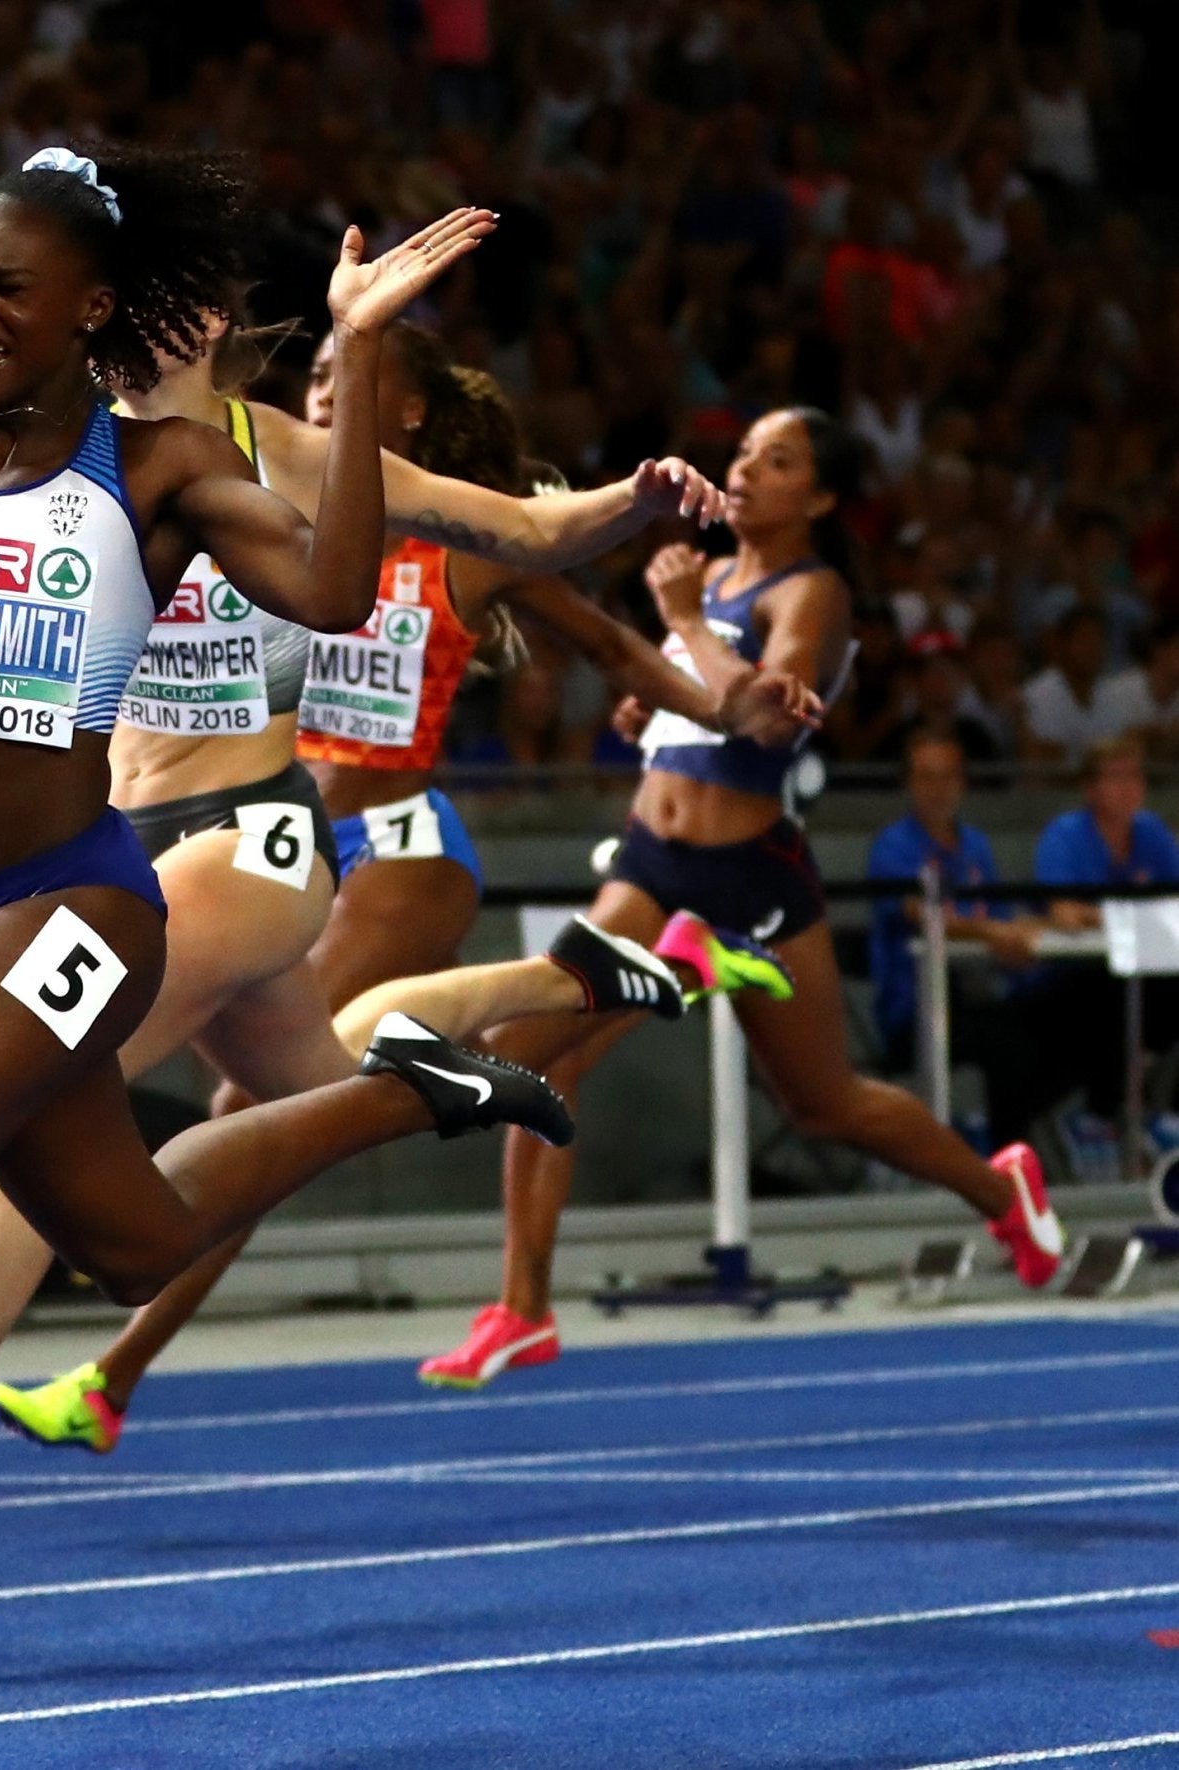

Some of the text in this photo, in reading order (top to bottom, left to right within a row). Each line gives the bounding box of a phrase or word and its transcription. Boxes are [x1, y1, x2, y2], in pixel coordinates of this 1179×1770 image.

[311, 640, 411, 695] MUEL
[190, 707, 252, 730] 2018
[347, 714, 398, 740] 2018
[264, 814, 300, 870] 6
[388, 811, 415, 850] 7
[38, 942, 101, 1012] 5
